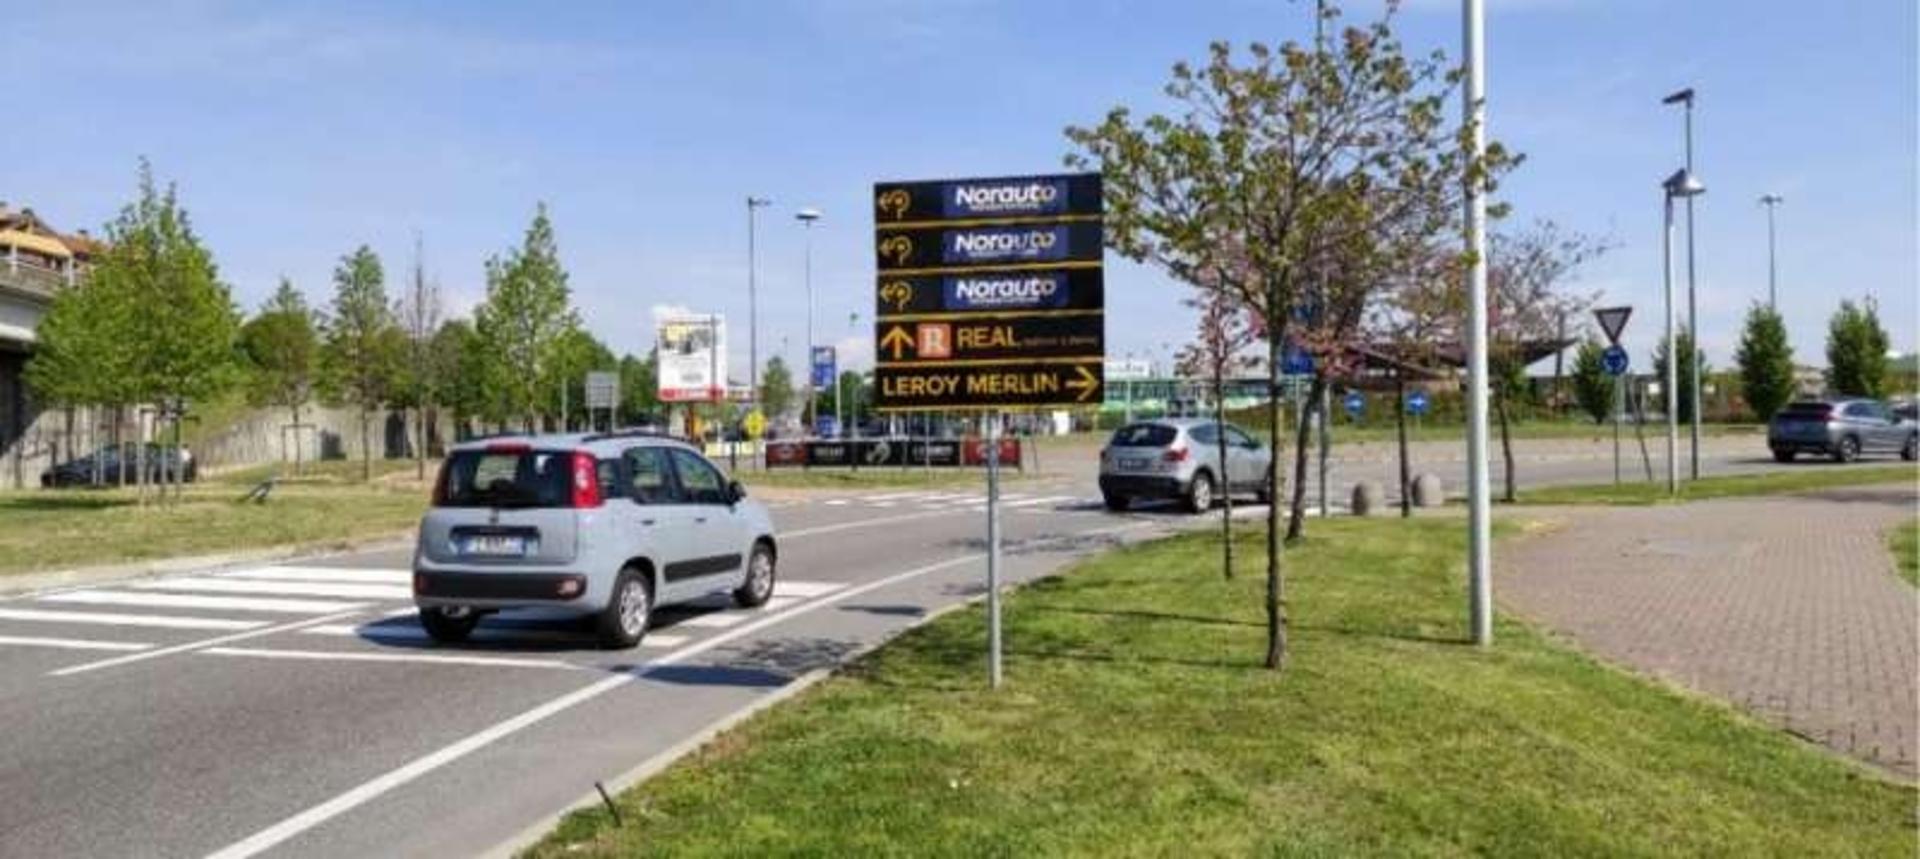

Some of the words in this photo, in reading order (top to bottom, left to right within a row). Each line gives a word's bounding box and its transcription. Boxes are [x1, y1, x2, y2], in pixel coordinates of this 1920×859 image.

[956, 184, 1056, 205] Norauto
[955, 231, 1056, 252] Norauto
[956, 278, 1056, 299] Norauto
[957, 326, 1021, 348] REAL
[883, 375, 961, 397] LEROY
[966, 372, 1060, 394] MERLIN
